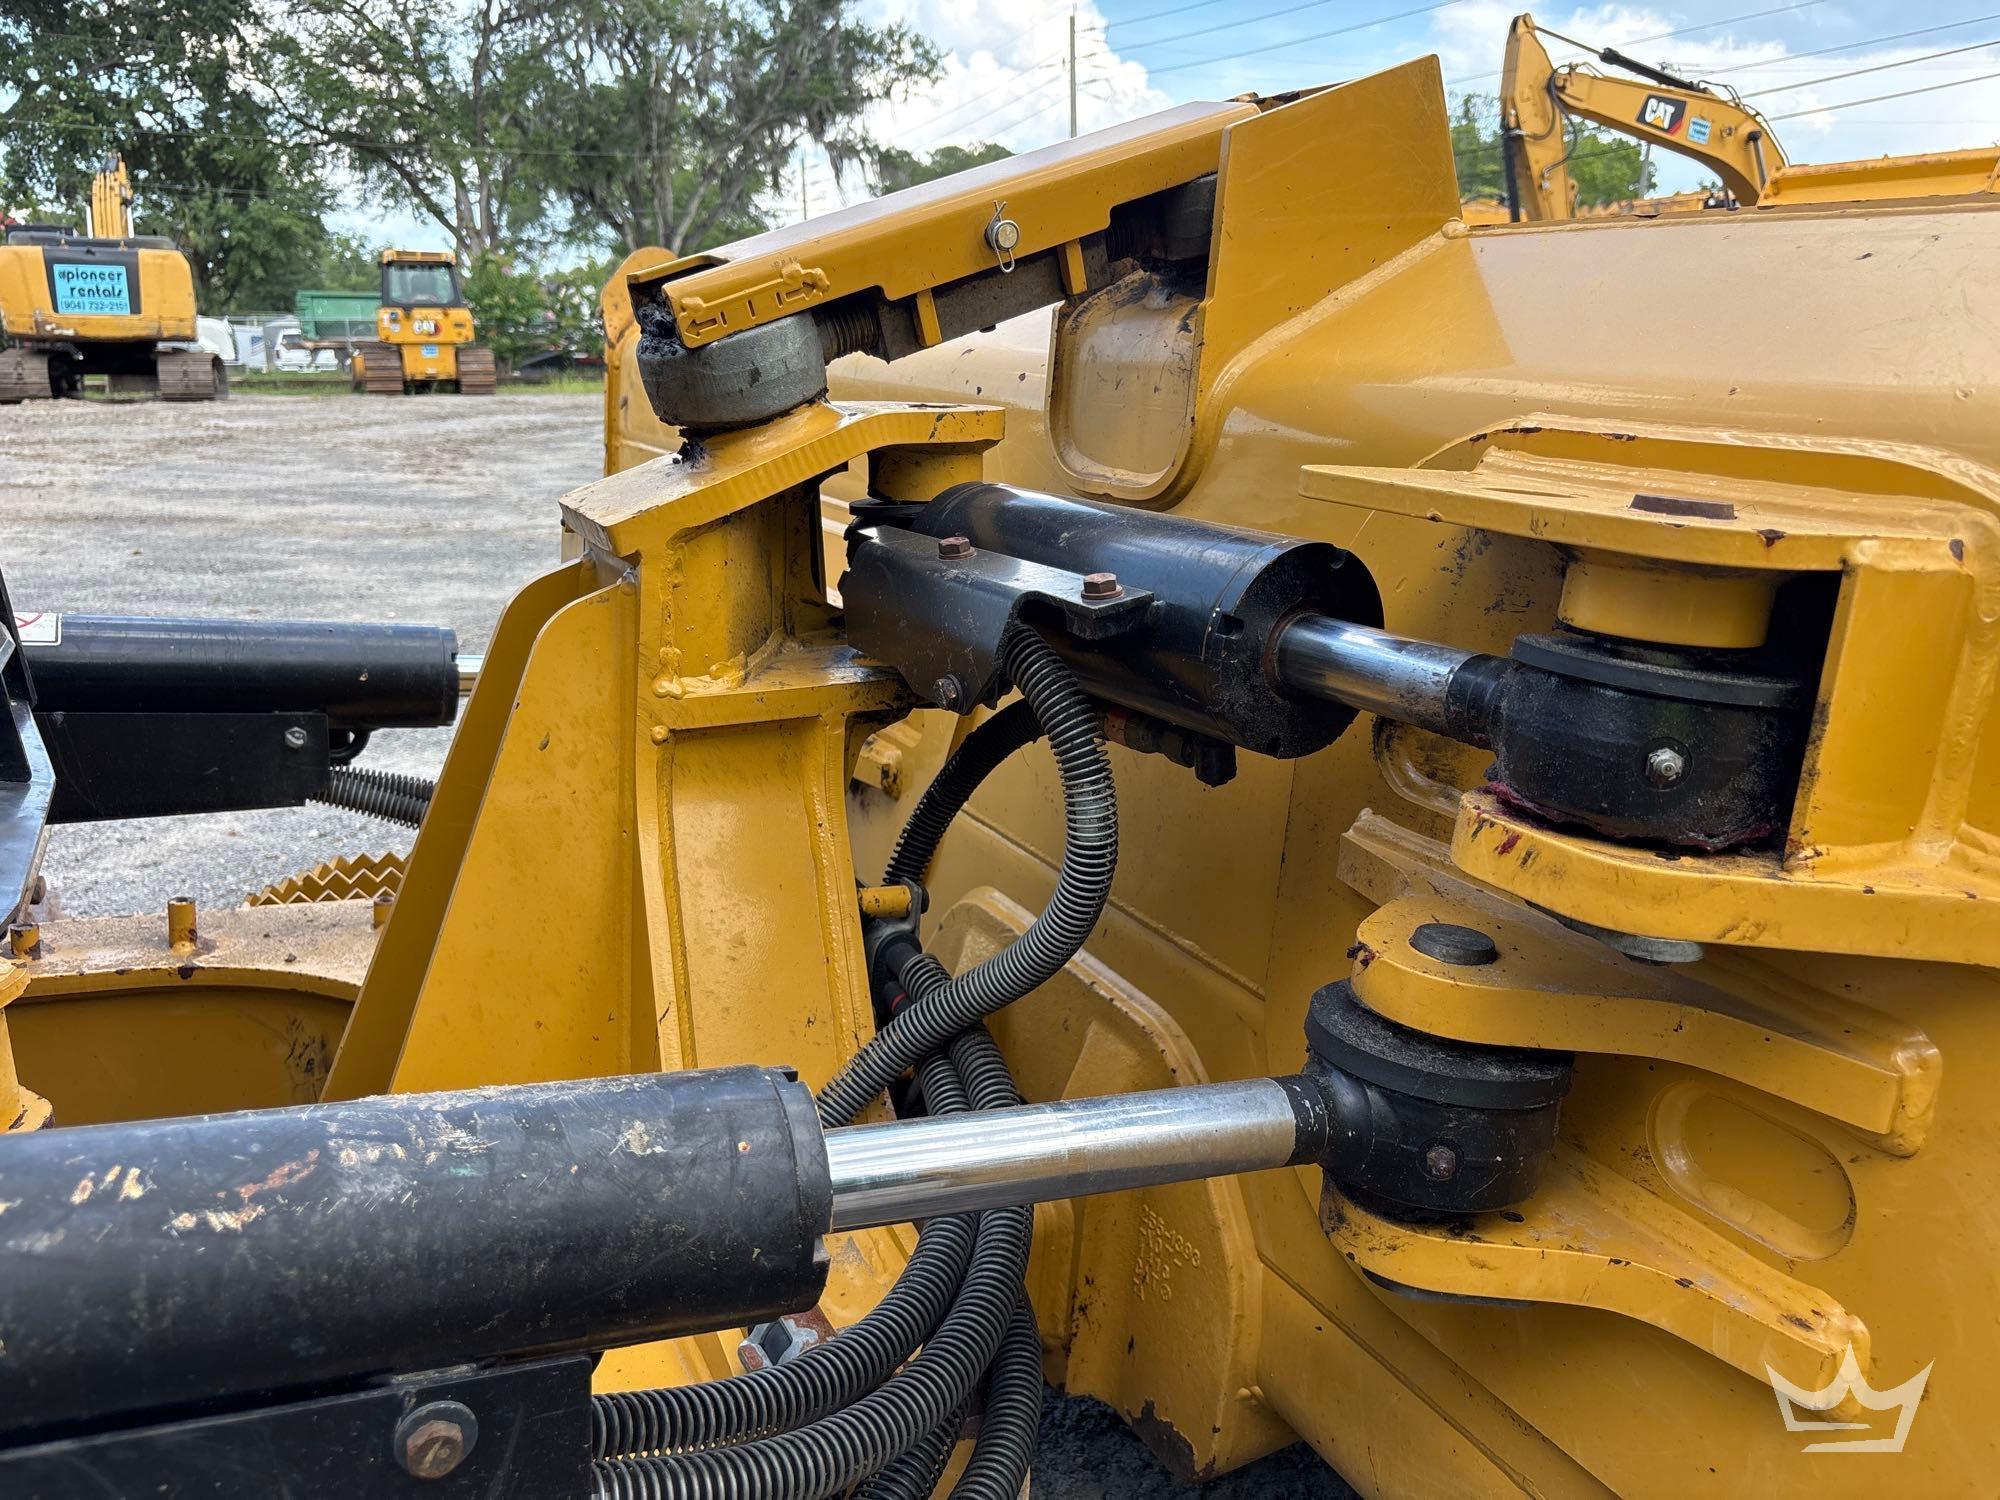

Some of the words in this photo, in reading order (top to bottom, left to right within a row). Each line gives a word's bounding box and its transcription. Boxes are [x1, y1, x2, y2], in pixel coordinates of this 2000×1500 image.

[1645, 98, 1675, 130] CAT
[66, 267, 122, 283] pioneer
[70, 285, 122, 298] rentals
